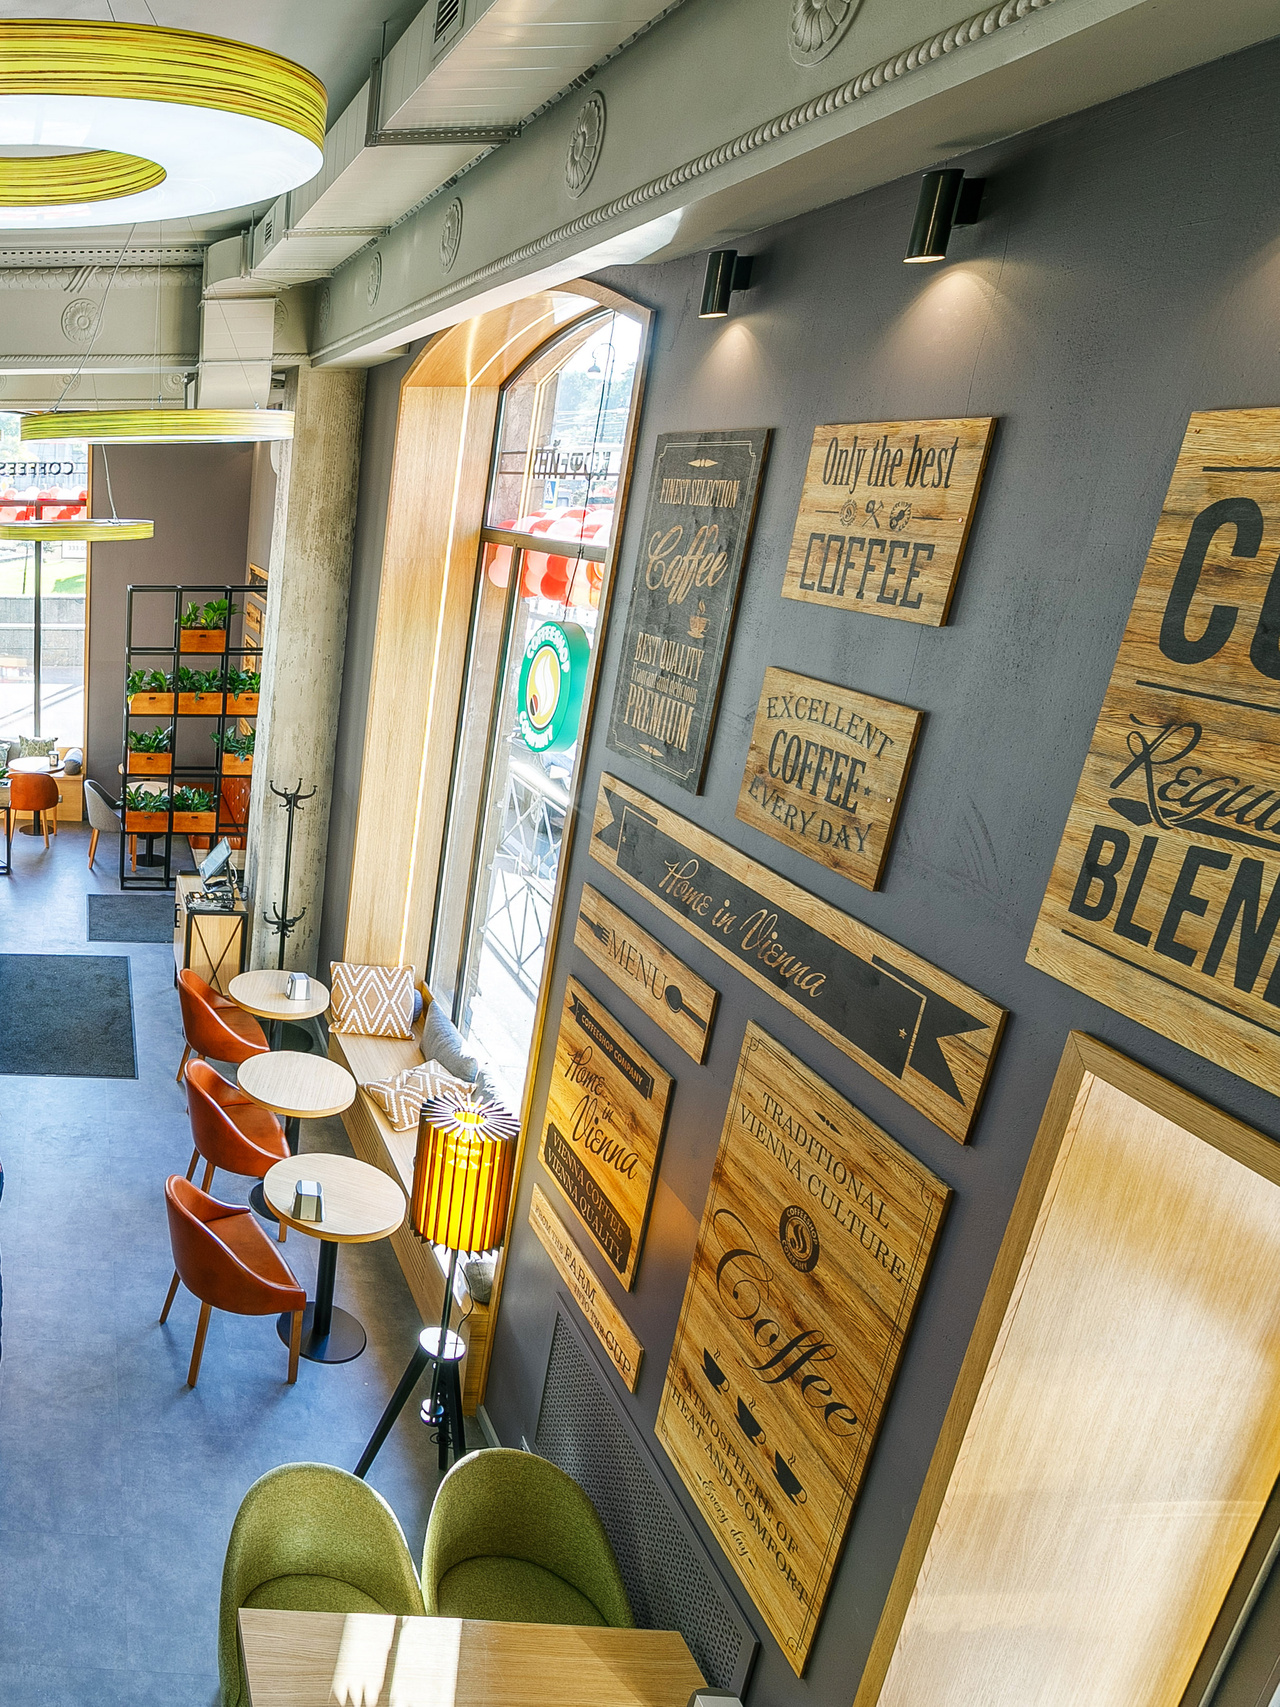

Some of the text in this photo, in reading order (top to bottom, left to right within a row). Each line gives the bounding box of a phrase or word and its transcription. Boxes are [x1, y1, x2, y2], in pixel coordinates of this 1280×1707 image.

[660, 478, 740, 508] FINEST SELECTION
[823, 434, 959, 494] Only the best
[646, 524, 728, 604] Coffee
[800, 532, 935, 609] COFFEE
[527, 625, 570, 673] COFFEESHOP
[634, 631, 705, 681] BEST QUALITY
[623, 683, 694, 752] PREMIUM
[767, 696, 894, 761] EXCELLENT
[769, 729, 866, 814] COFFEE
[748, 775, 873, 853] EVERY DAY
[658, 859, 826, 998] Home in Vienna
[1068, 824, 1280, 1006] BLEN
[609, 929, 668, 1000] MENU
[564, 1046, 605, 1095] Home
[581, 1016, 643, 1085] COFFEESHOP COMPANY
[570, 1095, 639, 1179] Vienna
[602, 1102, 614, 1123] in
[553, 1132, 625, 1240] VIENNA COFFEE
[740, 1103, 905, 1284] VIENNA CULTURE
[763, 1092, 890, 1229] TRADITIONAL
[547, 1147, 624, 1264] VIENNA QUALITY
[786, 1206, 818, 1245] COFFEESHOP
[534, 1204, 552, 1236] FROM
[564, 1244, 597, 1307] FARM
[781, 1239, 809, 1271] COMPANY
[573, 1284, 590, 1313] INTO
[605, 1330, 631, 1375] CUP
[713, 1209, 857, 1437] Coffee
[671, 1386, 808, 1606] HEAT AND COMFORT
[684, 1382, 799, 1556] ATMOSPHERE OF
[702, 1480, 749, 1558] Every day
